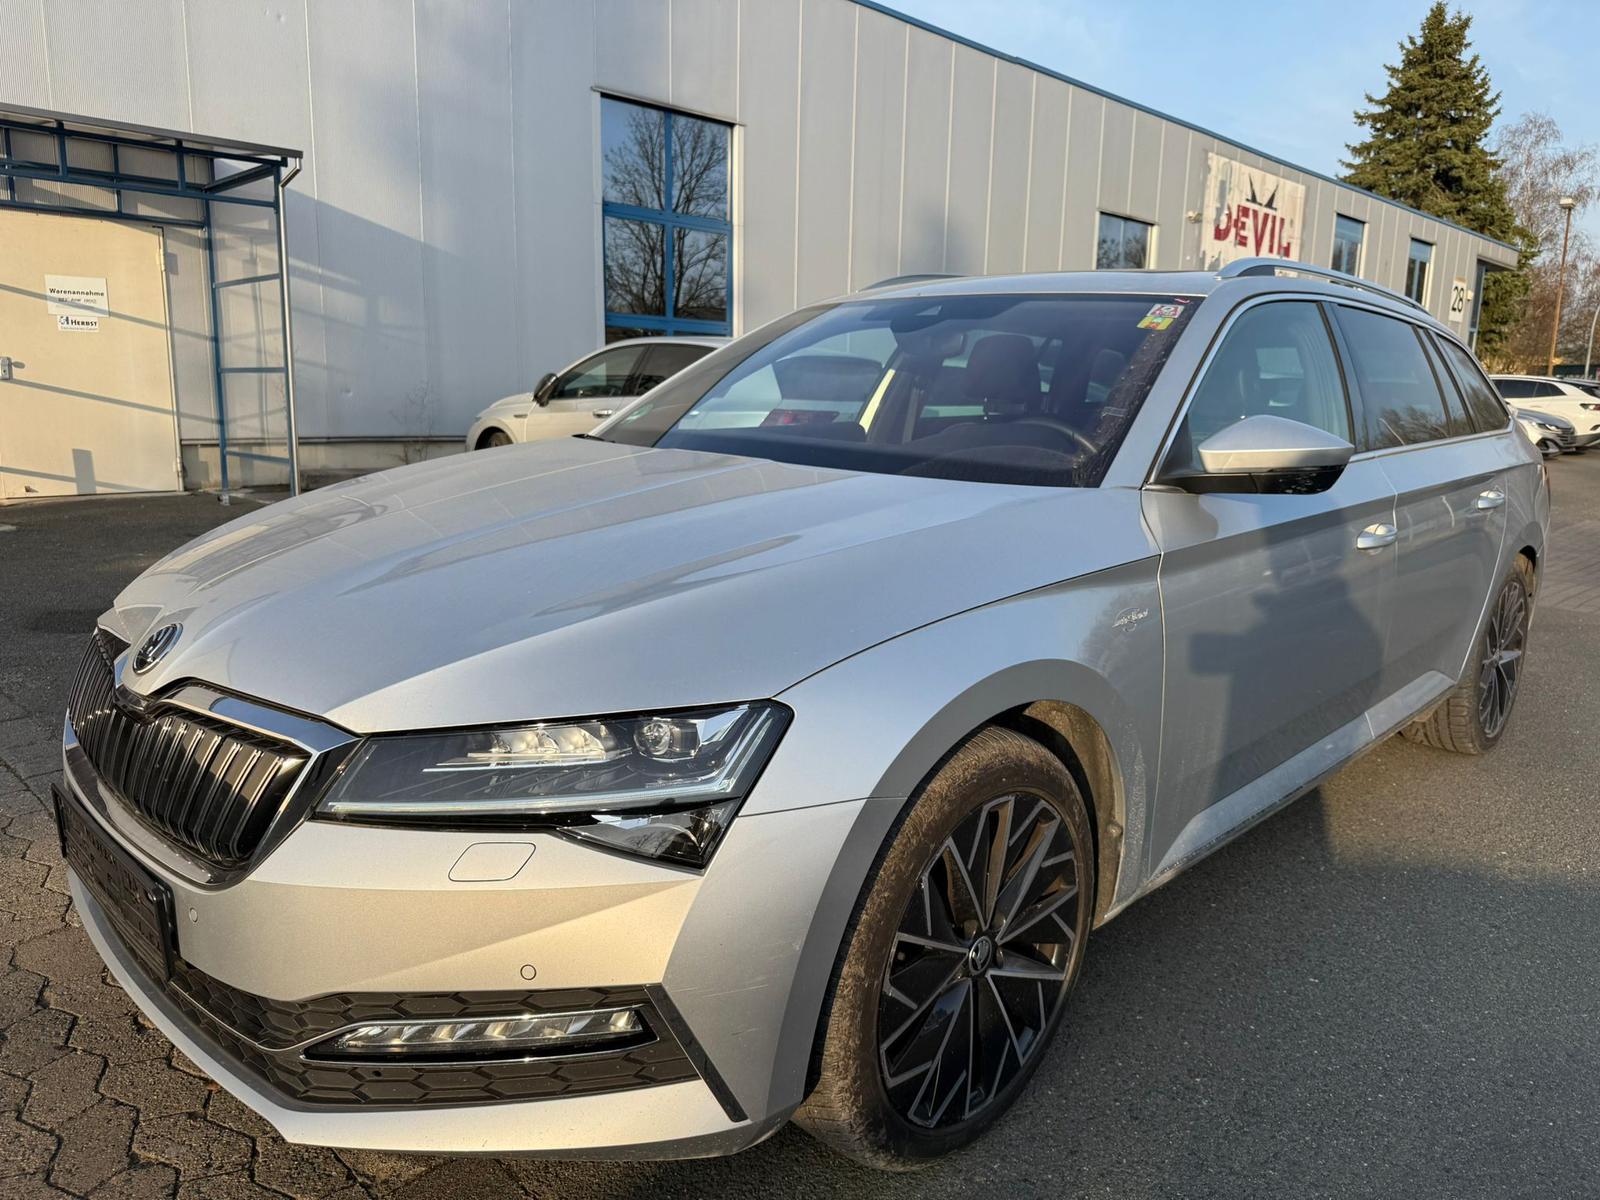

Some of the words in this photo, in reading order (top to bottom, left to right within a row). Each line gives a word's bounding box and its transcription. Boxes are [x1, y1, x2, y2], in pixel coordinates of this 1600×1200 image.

[1214, 203, 1291, 258] DEVIL
[49, 288, 104, 296] Warenannahme
[1452, 286, 1464, 312] 28
